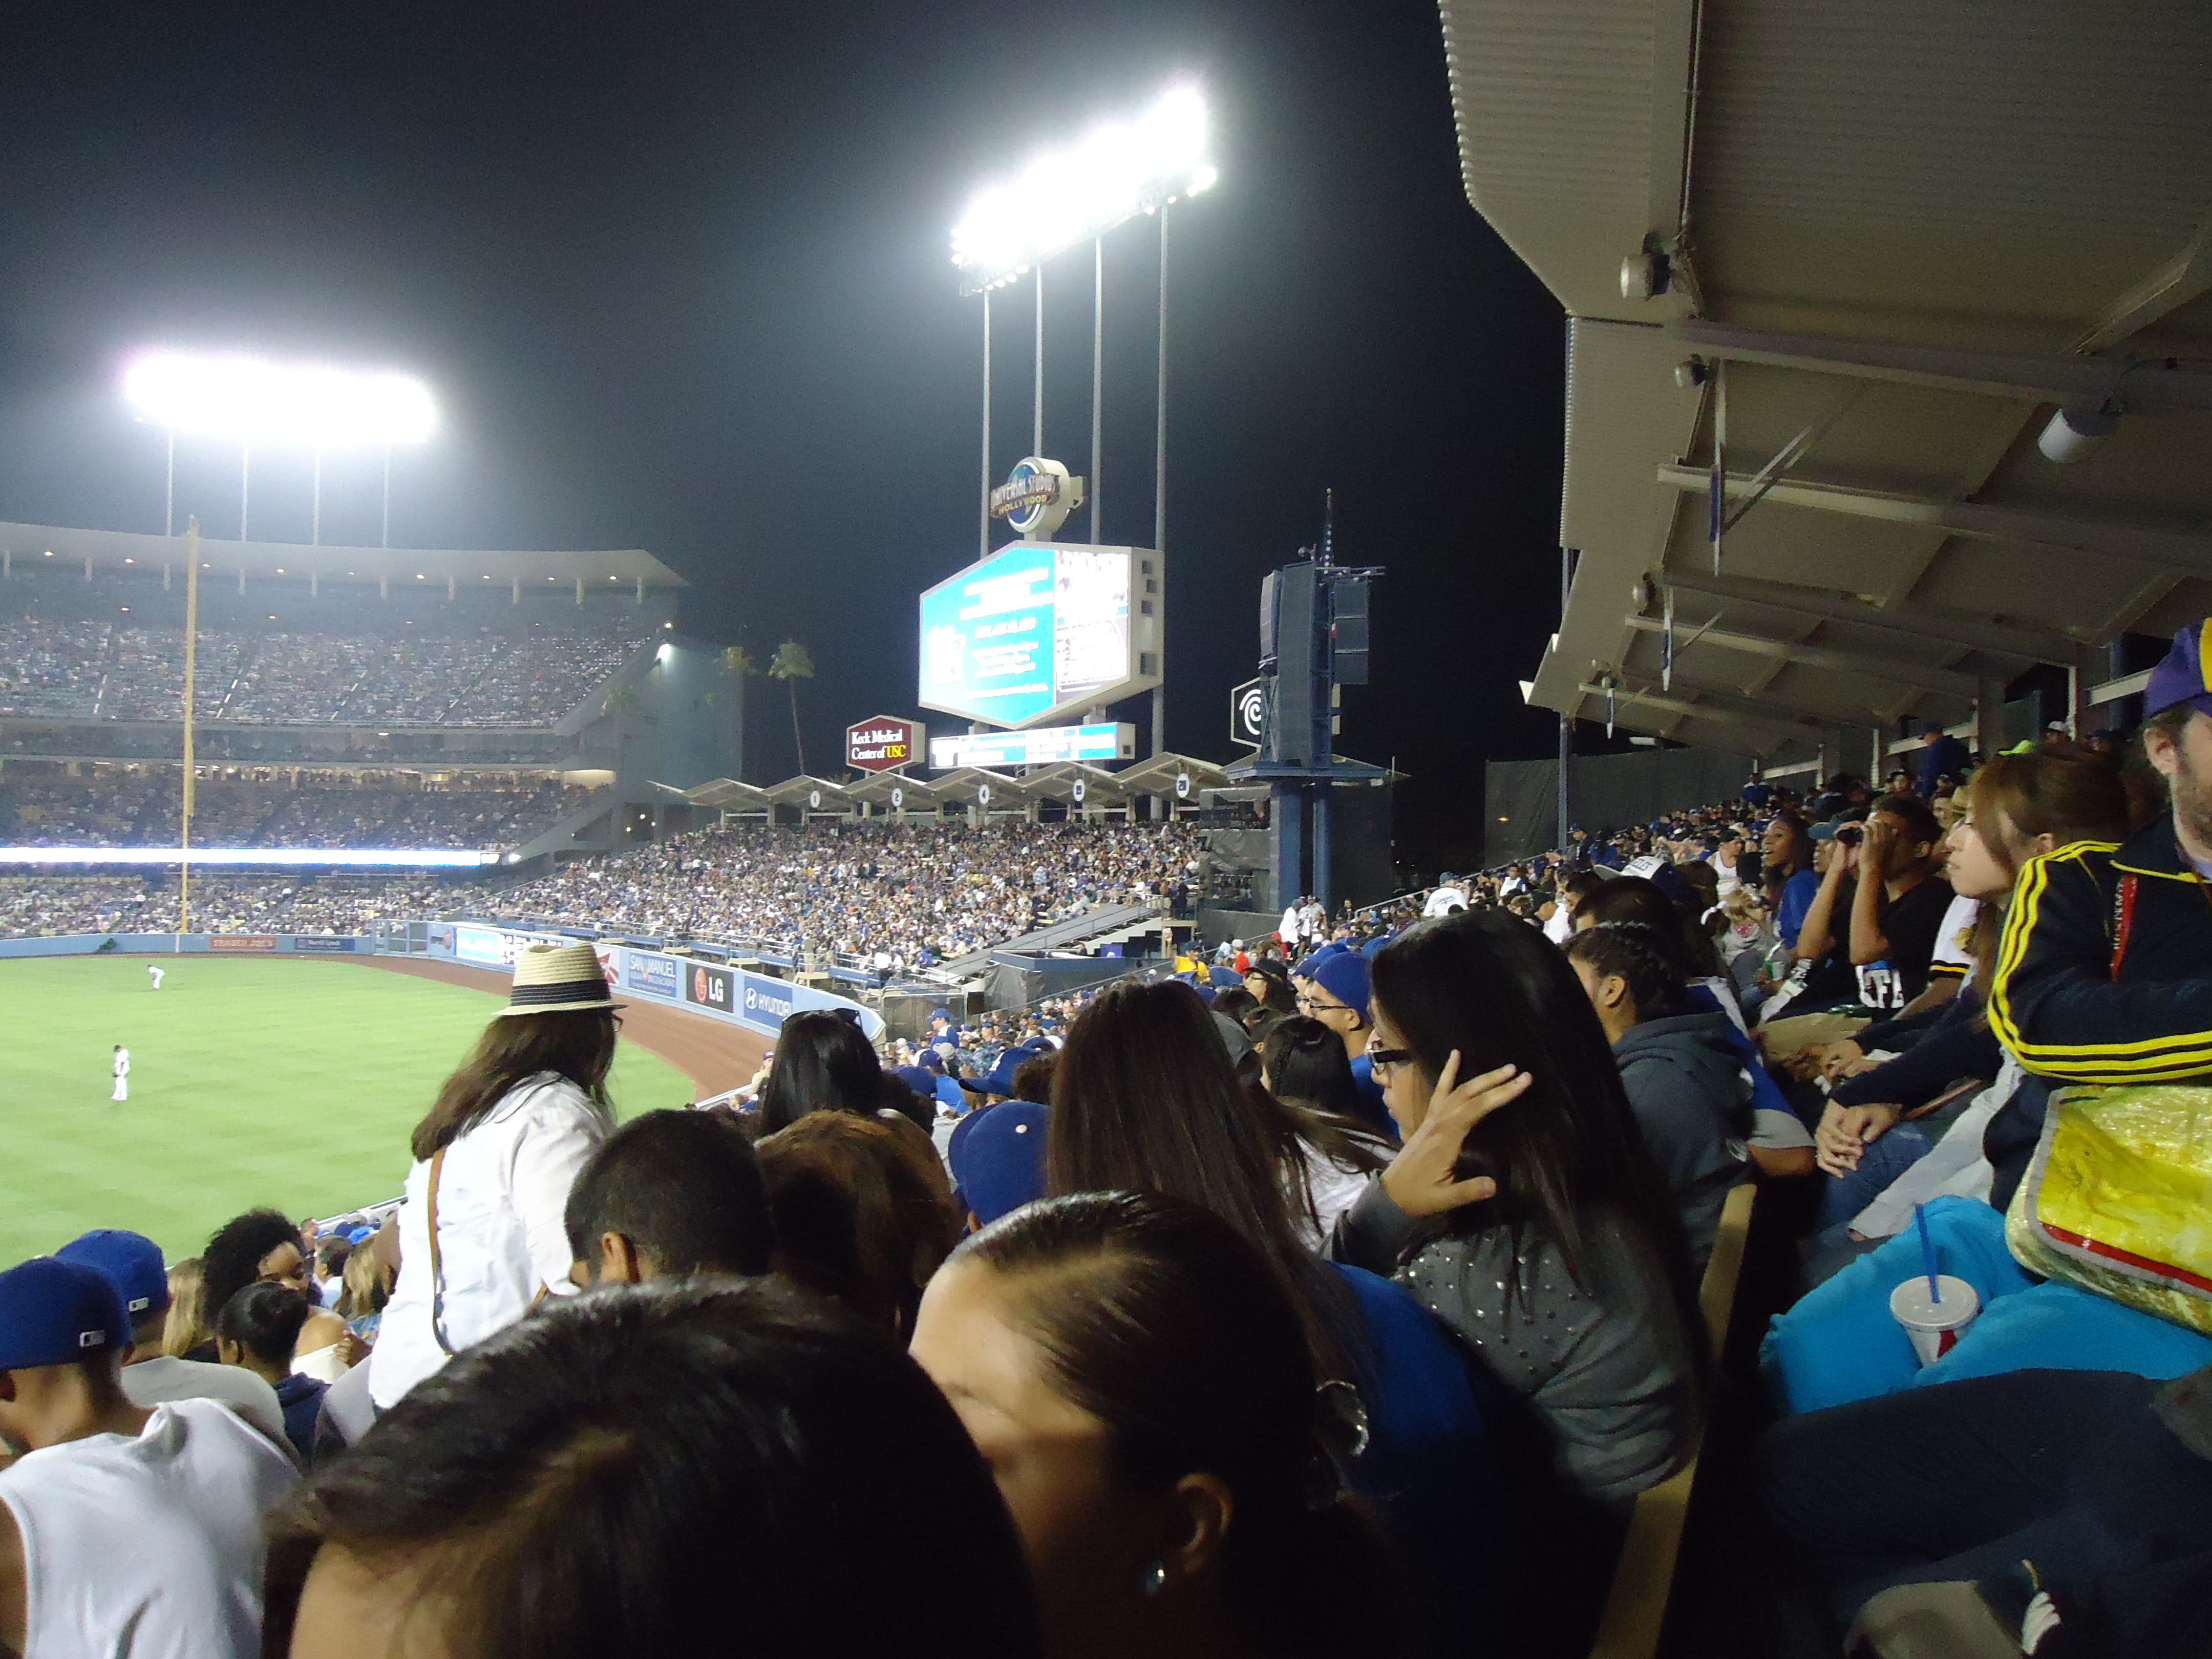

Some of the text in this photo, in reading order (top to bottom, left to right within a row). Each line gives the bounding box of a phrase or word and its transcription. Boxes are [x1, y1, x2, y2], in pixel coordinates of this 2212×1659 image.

[999, 495, 1048, 514] HOLLYWOOD
[871, 729, 903, 743] Medical
[852, 745, 907, 760] Center of USC
[709, 976, 724, 1003] LG
